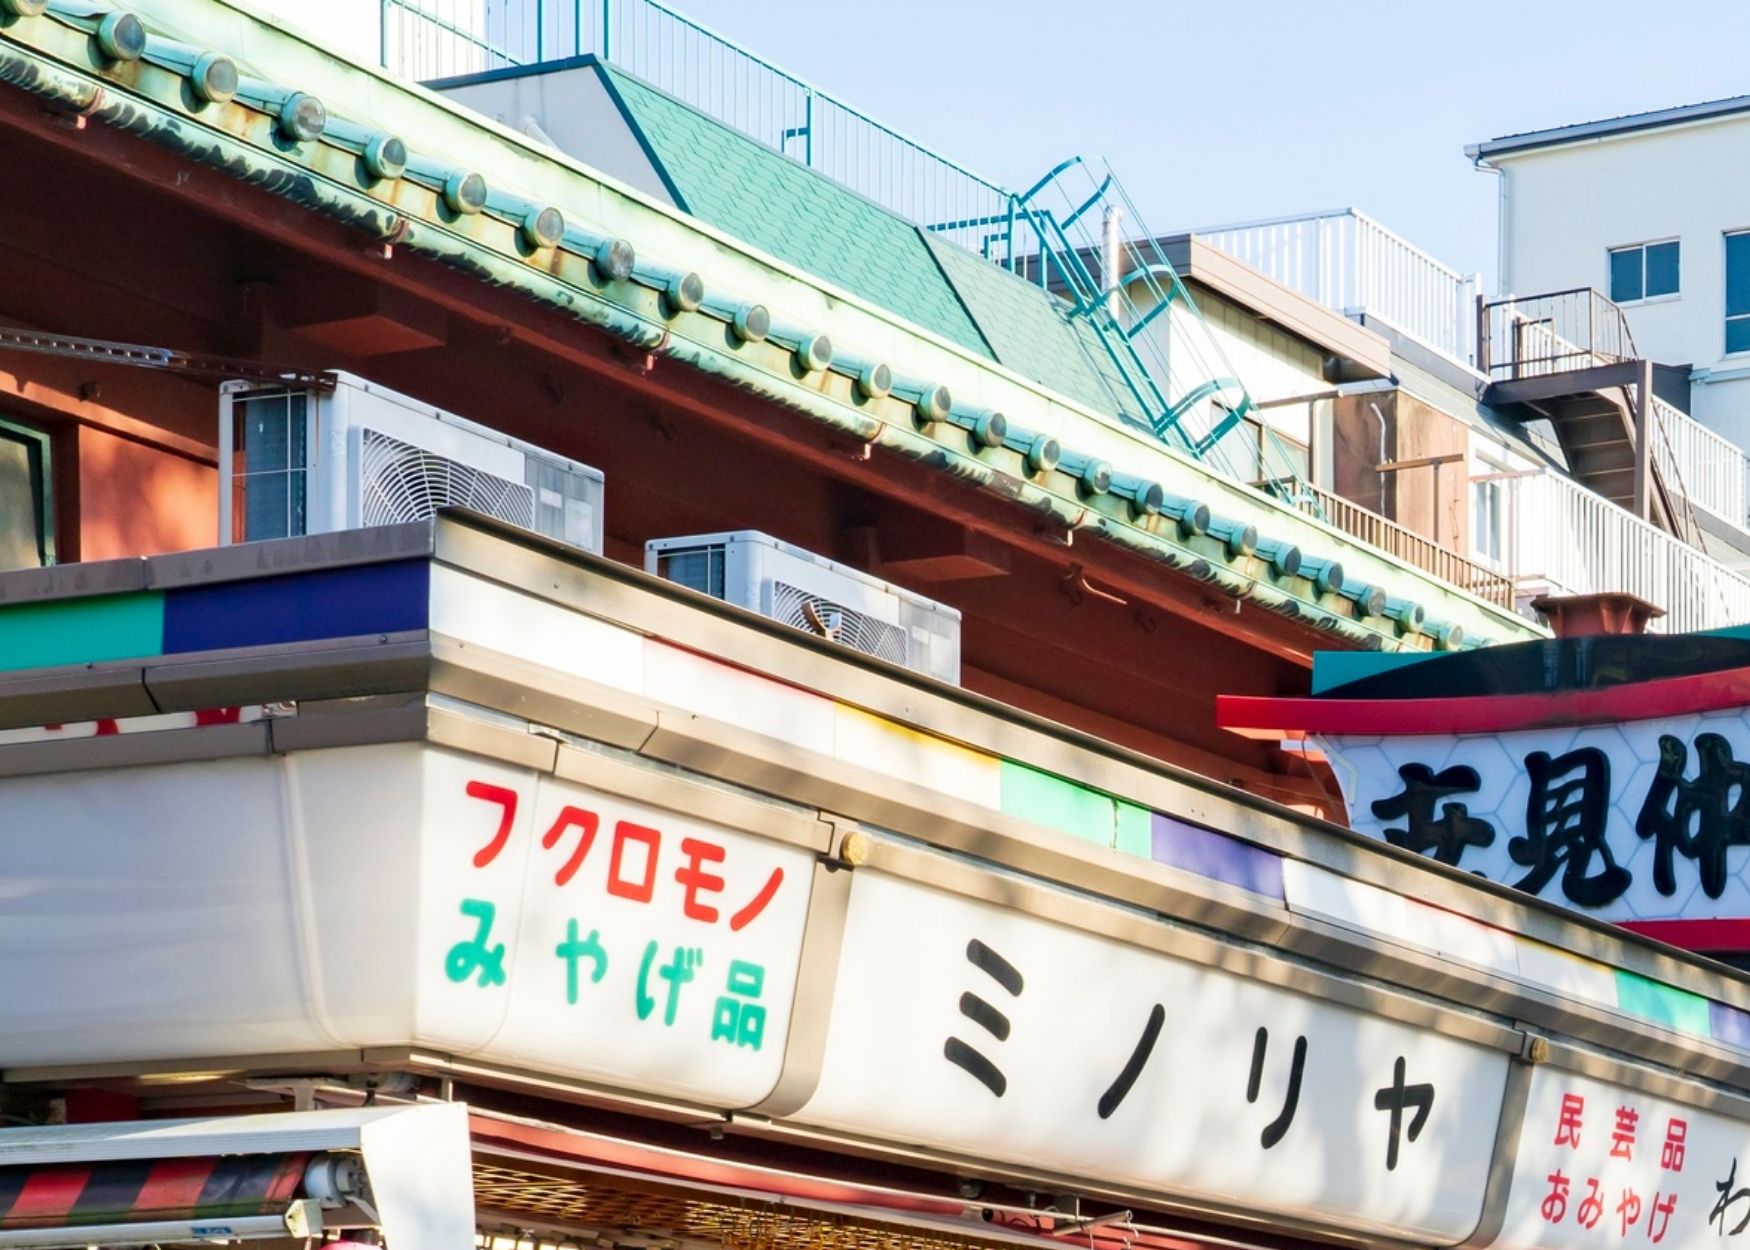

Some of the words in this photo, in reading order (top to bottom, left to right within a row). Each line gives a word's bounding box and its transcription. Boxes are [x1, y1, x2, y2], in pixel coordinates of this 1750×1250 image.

[465, 781, 784, 931] フクロモノ
[445, 898, 768, 1051] みやげ品
[943, 938, 1435, 1171] ミノリヤ
[1540, 1169, 1679, 1244] おみやげ
[1553, 1093, 1687, 1172] 民芸品
